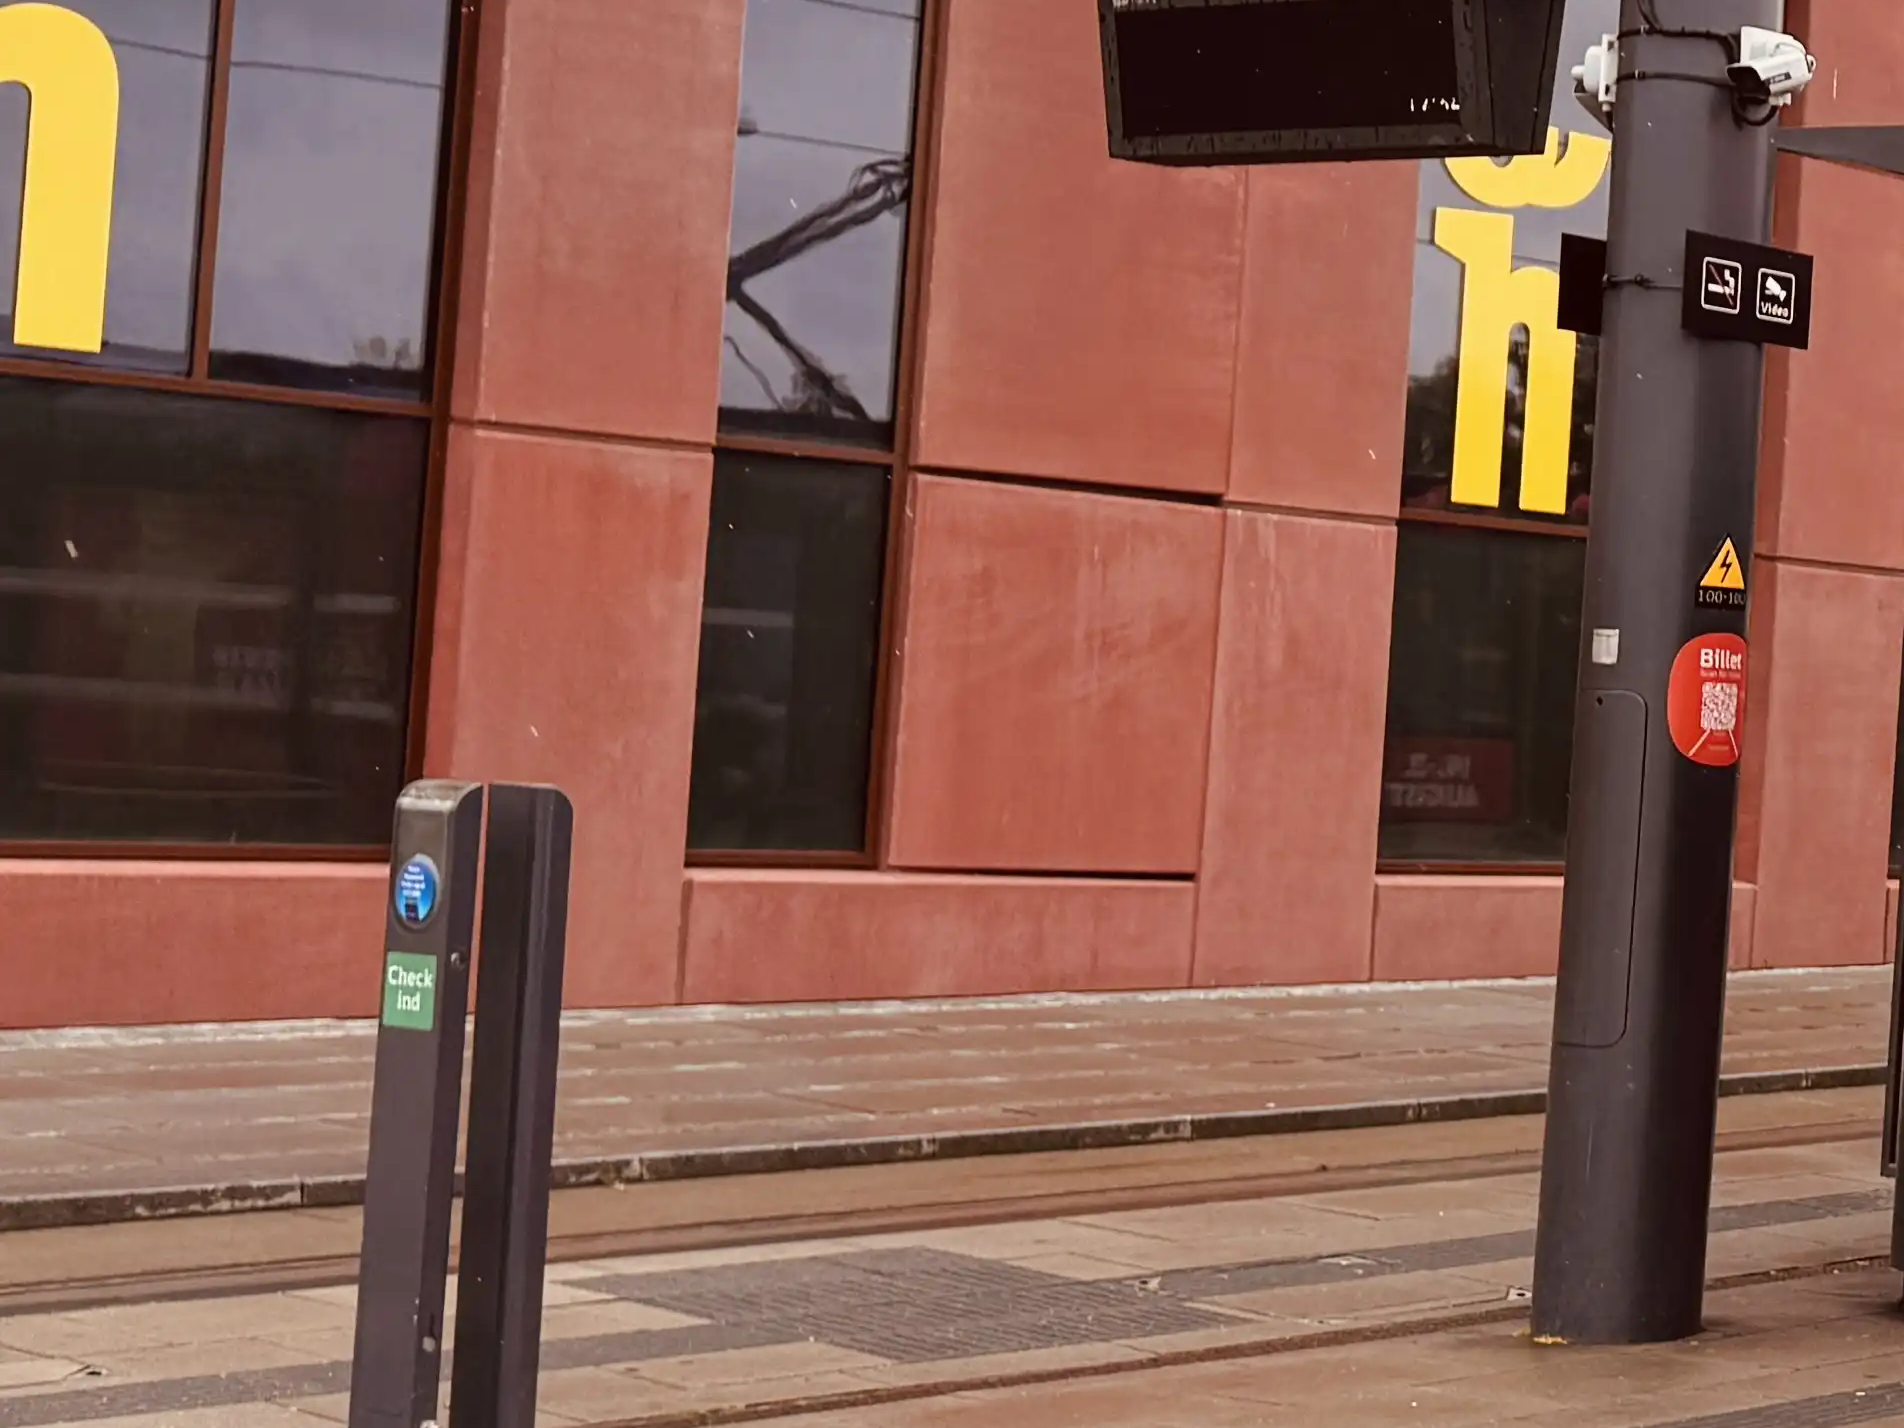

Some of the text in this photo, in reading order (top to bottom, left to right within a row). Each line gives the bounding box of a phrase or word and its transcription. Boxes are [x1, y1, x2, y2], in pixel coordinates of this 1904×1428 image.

[1761, 301, 1789, 318] Video
[1700, 648, 1742, 670] Billet
[388, 964, 433, 988] Check
